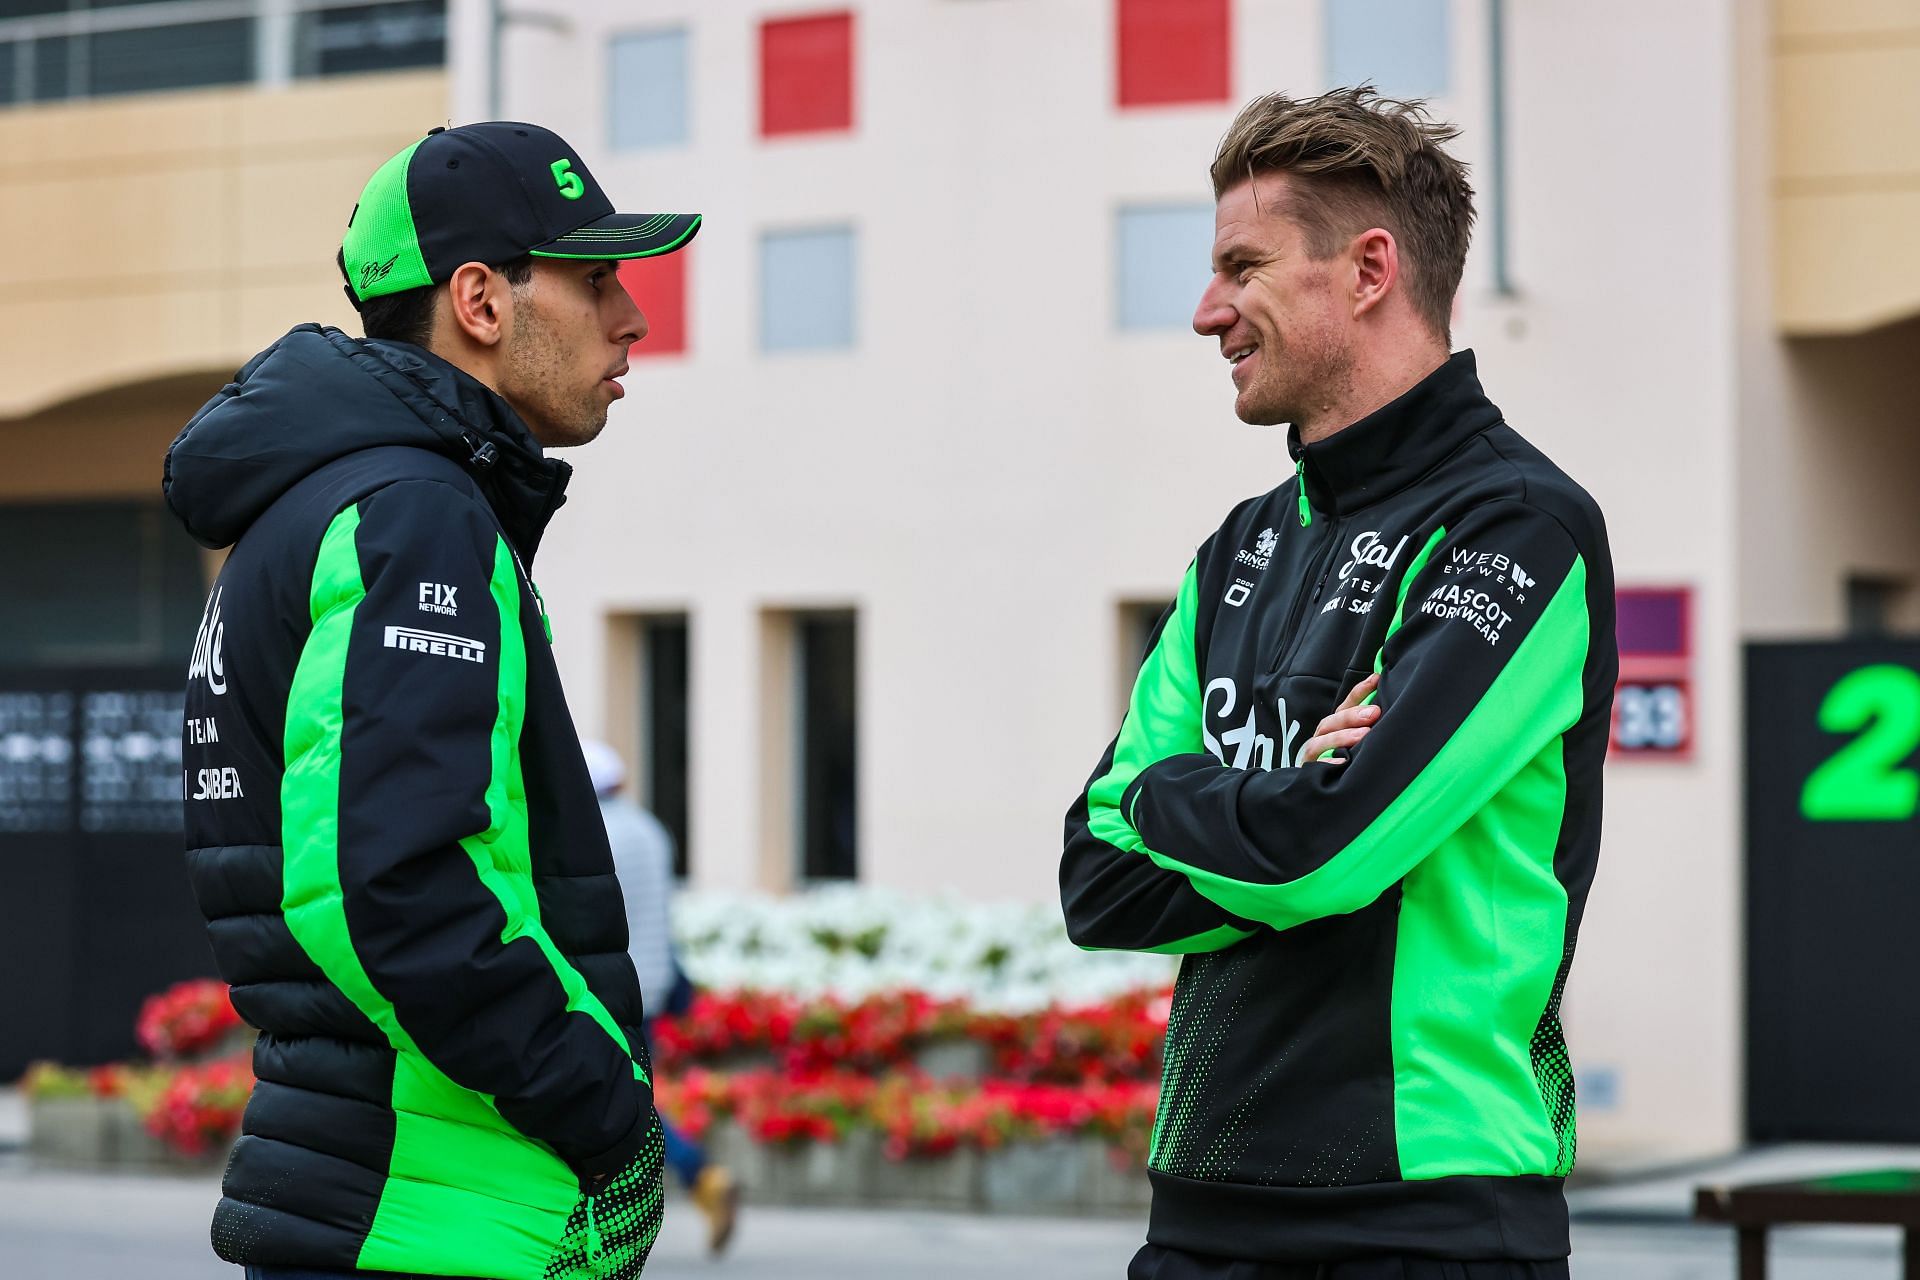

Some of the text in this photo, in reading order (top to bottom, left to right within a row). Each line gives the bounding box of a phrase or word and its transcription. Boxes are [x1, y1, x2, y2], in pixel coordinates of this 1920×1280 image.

[550, 158, 585, 201] 5
[1452, 547, 1510, 571] WEB
[419, 582, 458, 608] FIX
[1235, 577, 1255, 588] CODE
[1350, 577, 1385, 594] TEA
[418, 602, 457, 617] NETWORK
[1420, 600, 1500, 646] WORKWEAR
[1426, 584, 1512, 630] MASCOT
[188, 579, 227, 695] take
[383, 625, 486, 664] PIRELLI
[187, 717, 219, 745] TEAM
[1798, 662, 1920, 822] 2
